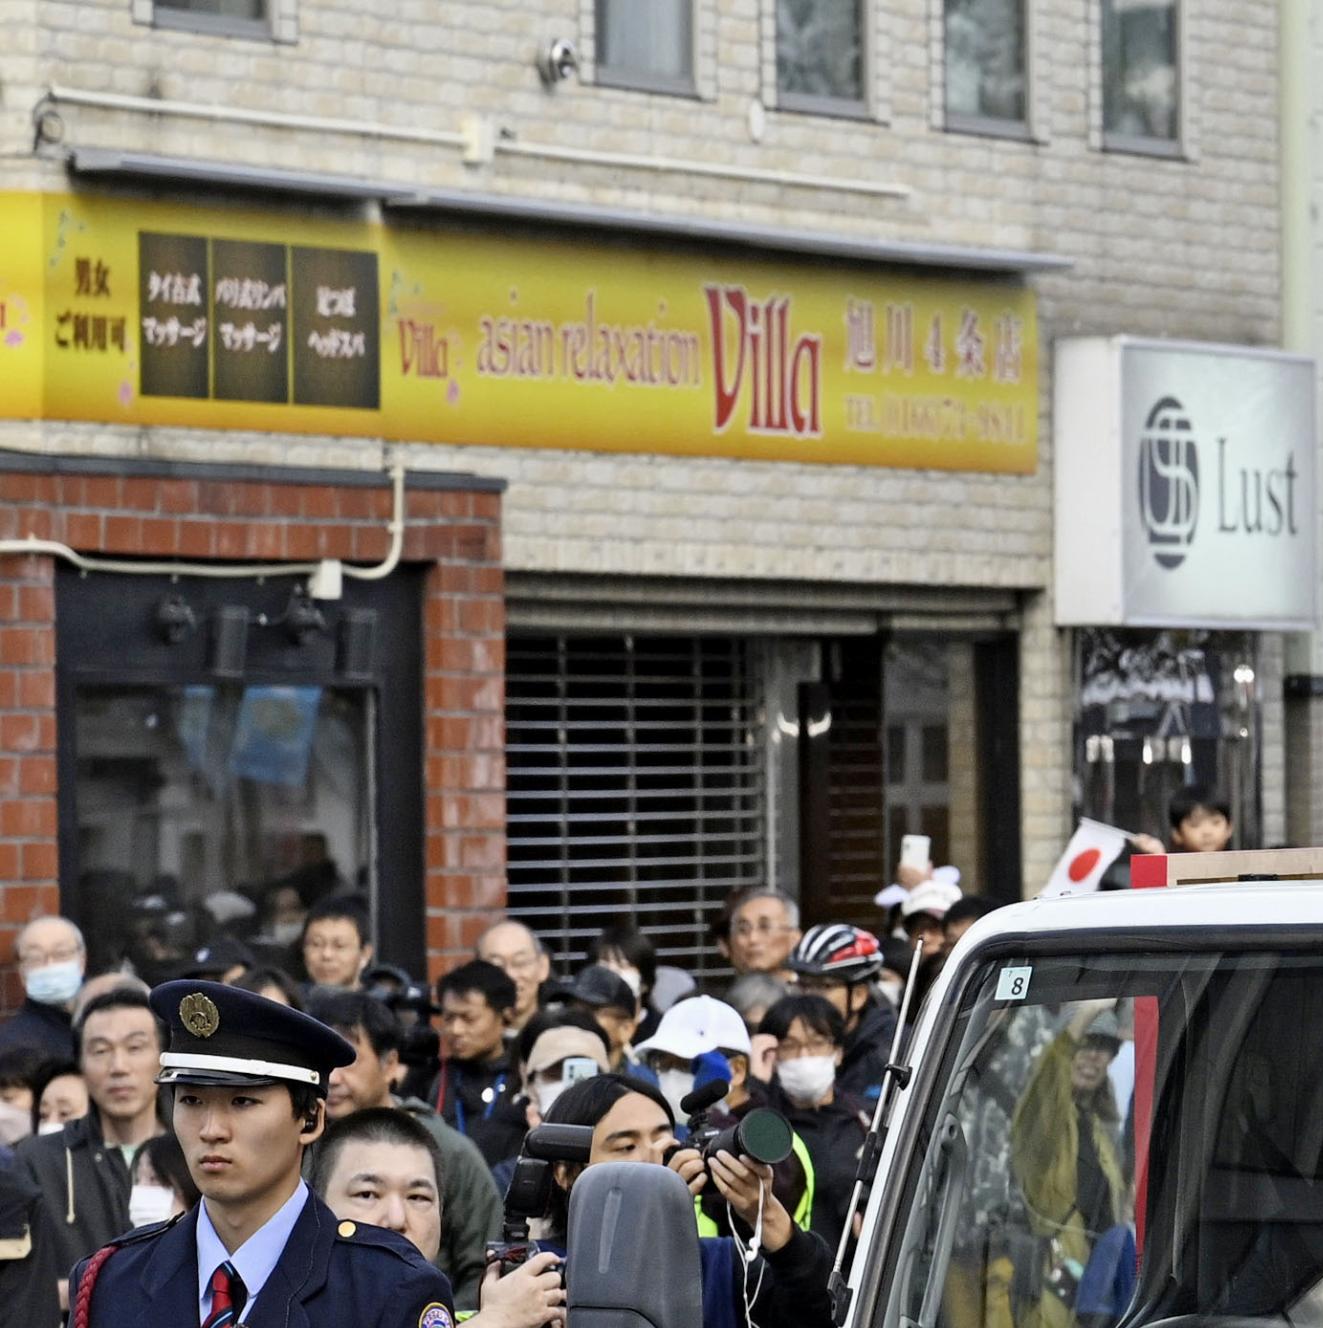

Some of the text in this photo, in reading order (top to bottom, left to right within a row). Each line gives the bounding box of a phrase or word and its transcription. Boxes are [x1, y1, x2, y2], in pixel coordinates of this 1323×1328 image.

[75, 257, 110, 297] 男女
[148, 270, 202, 306] タイ古式
[55, 311, 126, 353] ご利用可
[142, 316, 208, 347] マッサージ
[219, 321, 282, 354] マッサージ
[399, 318, 448, 378] Villa
[477, 284, 823, 438] asian relaxation Villa
[1216, 436, 1299, 537] Lust
[1011, 977, 1024, 996] 8
